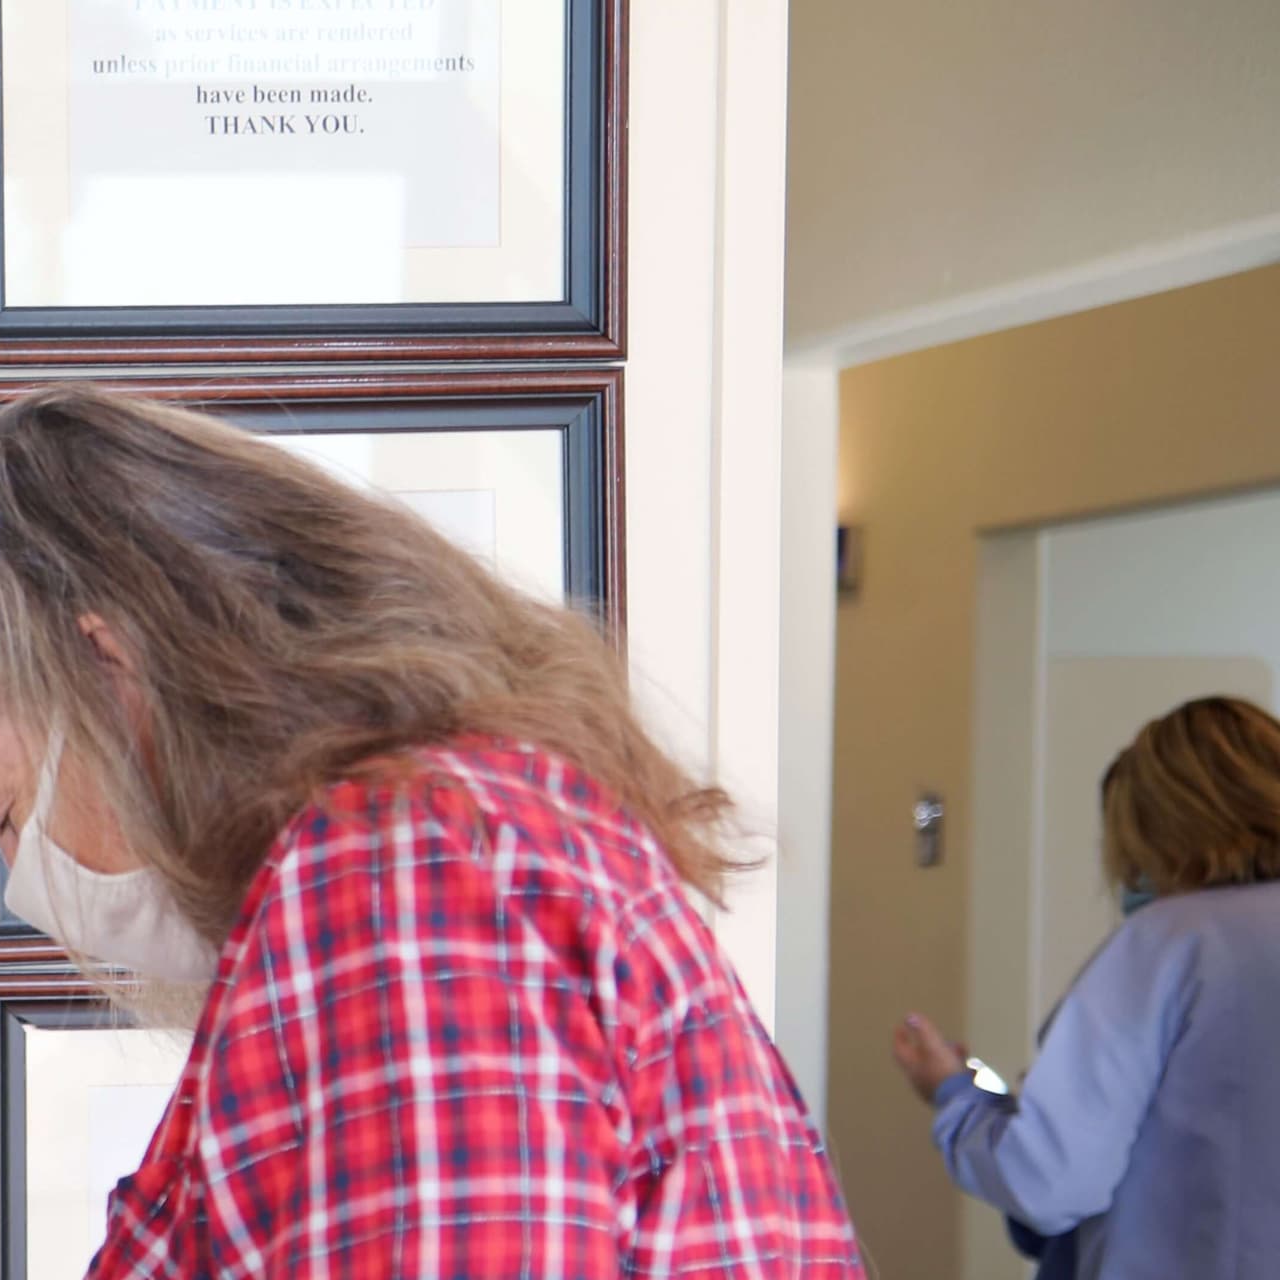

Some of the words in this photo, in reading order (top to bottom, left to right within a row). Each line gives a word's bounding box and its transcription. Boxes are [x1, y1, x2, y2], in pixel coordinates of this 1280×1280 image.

[183, 23, 269, 42] services
[275, 27, 310, 42] are
[316, 20, 413, 42] rendered
[92, 54, 157, 75] unless
[164, 53, 220, 80] prior
[227, 51, 321, 73] financial
[327, 53, 475, 80] arrangements
[196, 84, 246, 104] have
[252, 83, 303, 104] been
[309, 83, 374, 104] made.
[204, 114, 296, 136] THANK
[303, 114, 366, 135] YOU.
